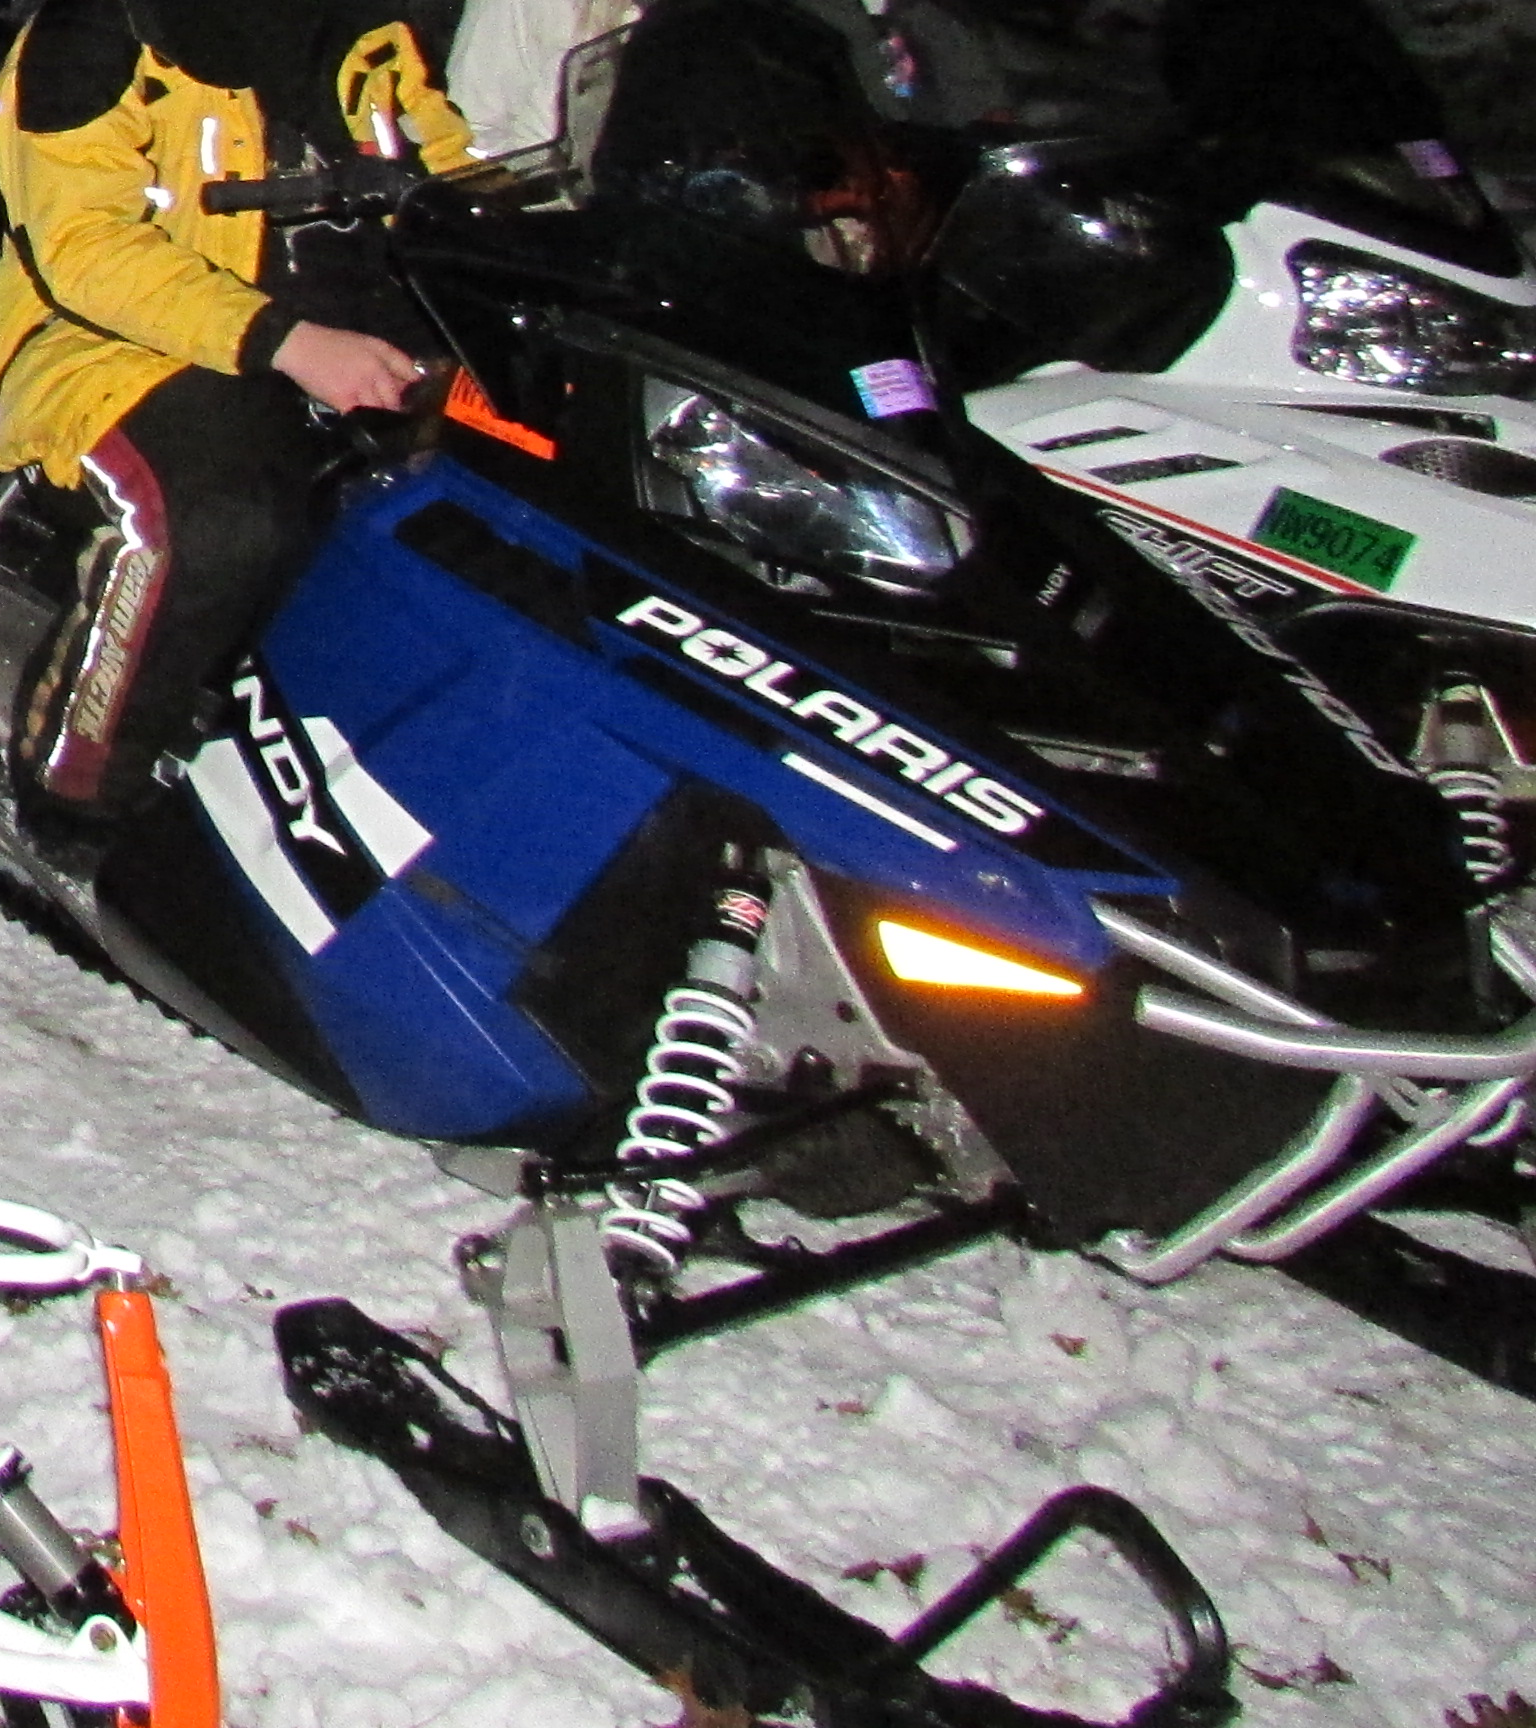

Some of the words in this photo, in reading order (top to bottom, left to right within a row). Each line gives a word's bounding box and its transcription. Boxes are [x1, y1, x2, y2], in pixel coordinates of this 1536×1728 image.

[1036, 562, 1072, 608] INDY
[232, 656, 348, 851] NDY
[615, 595, 1048, 836] POLARIS
